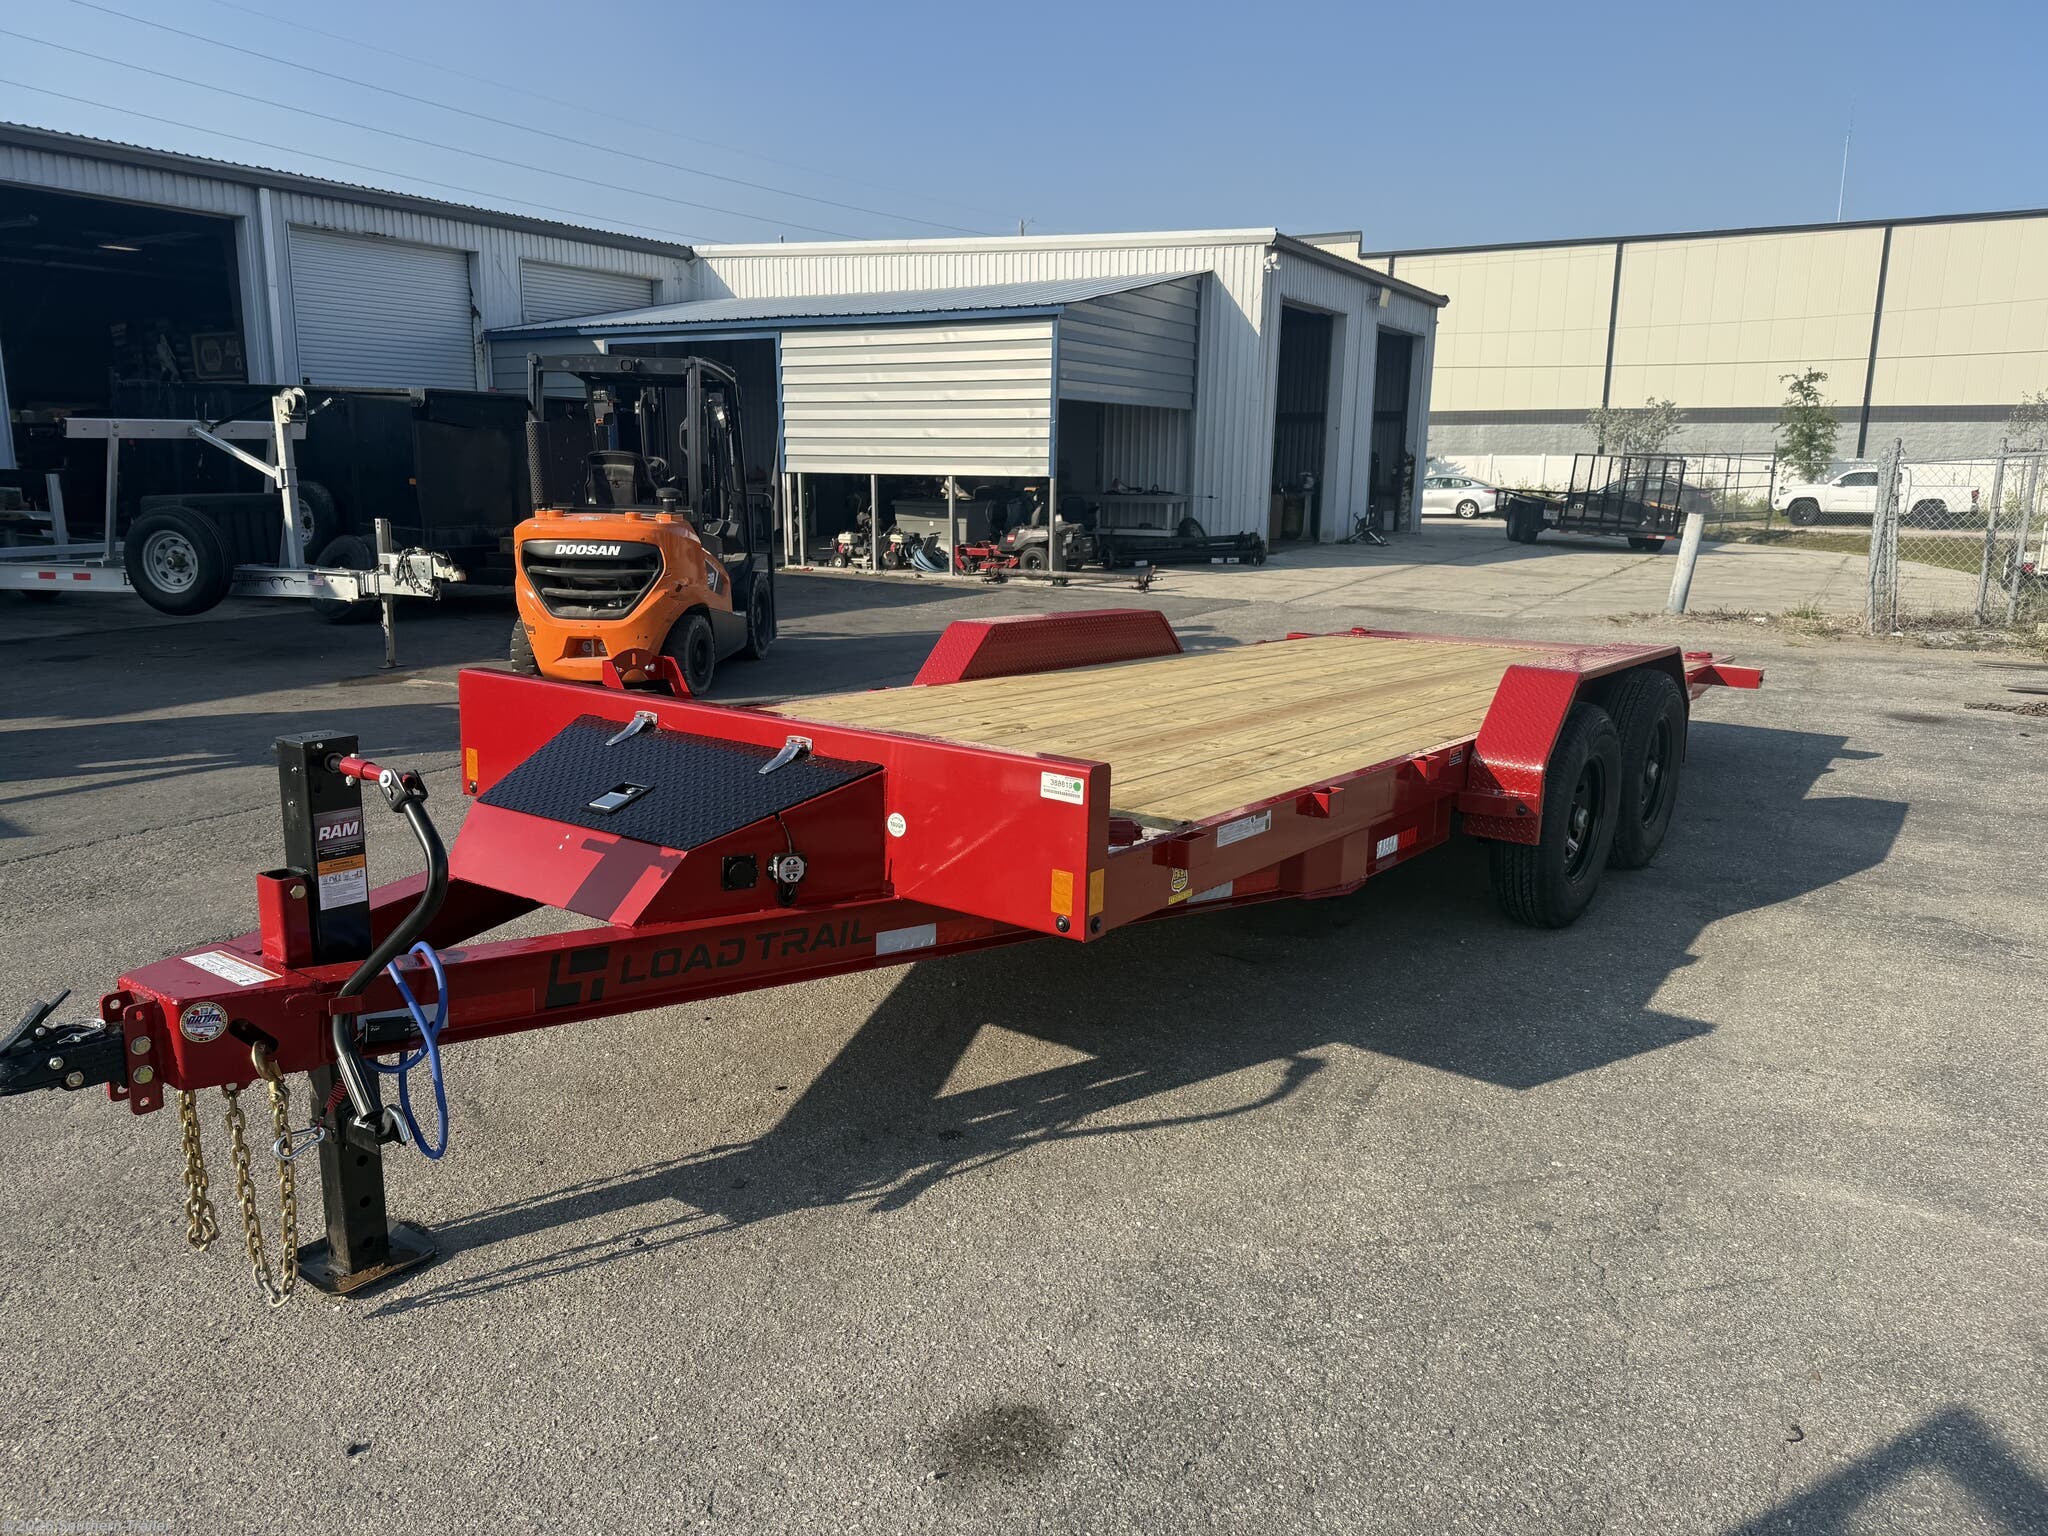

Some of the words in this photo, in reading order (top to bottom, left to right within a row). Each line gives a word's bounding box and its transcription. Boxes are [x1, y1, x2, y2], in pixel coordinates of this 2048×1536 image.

[555, 544, 621, 556] DOOSAN
[319, 821, 359, 840] RAM
[619, 937, 746, 985] LOAD
[755, 918, 873, 962] TRAIL
